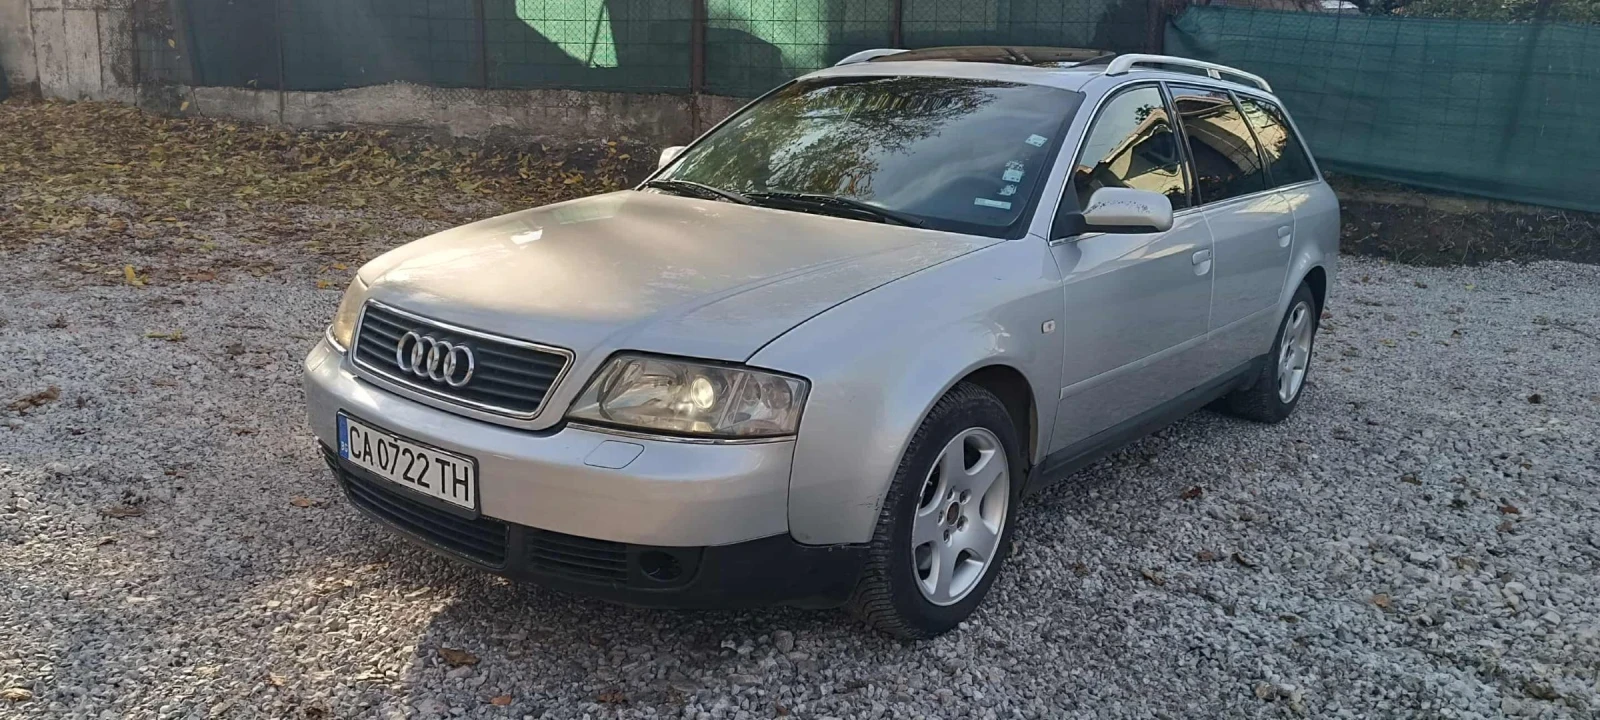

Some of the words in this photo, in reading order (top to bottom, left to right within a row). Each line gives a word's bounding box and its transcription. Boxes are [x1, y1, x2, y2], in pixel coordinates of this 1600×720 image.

[350, 426, 374, 466] CA
[378, 438, 430, 488] 0722
[435, 458, 469, 502] TH
